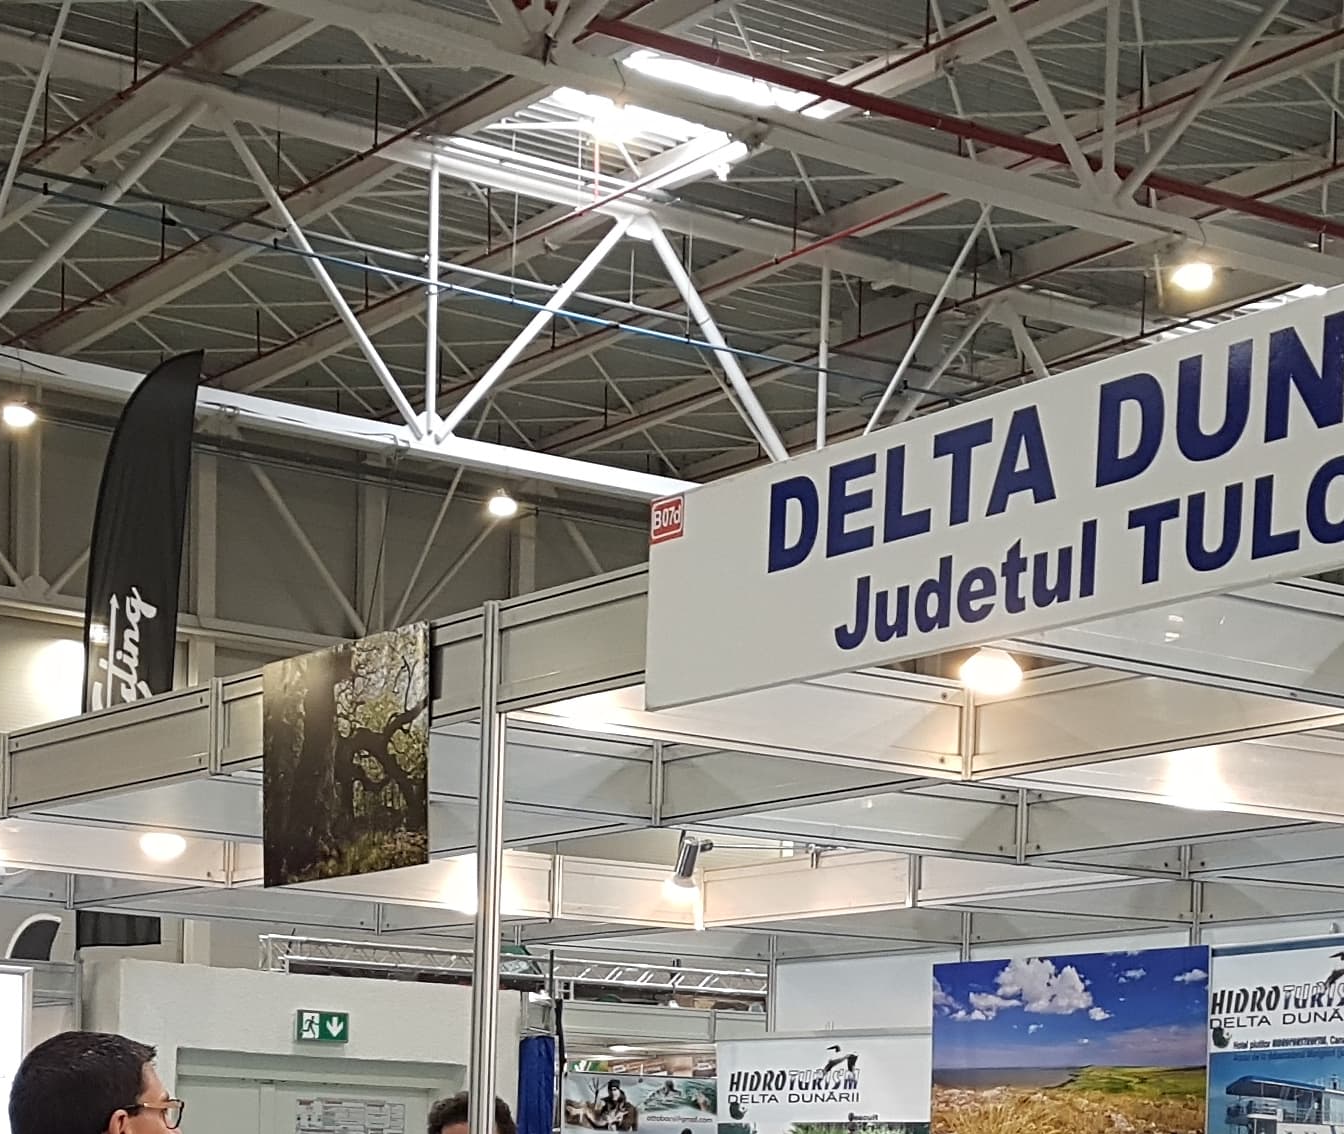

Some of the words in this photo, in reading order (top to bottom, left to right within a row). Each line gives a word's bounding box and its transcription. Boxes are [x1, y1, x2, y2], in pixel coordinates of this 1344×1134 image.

[767, 404, 1057, 574] DELTA
[834, 517, 1099, 651] Judetul
[1209, 1015, 1272, 1029] DELTA
[729, 1067, 861, 1092] HIDROTURISM
[727, 1093, 780, 1104] DELTA
